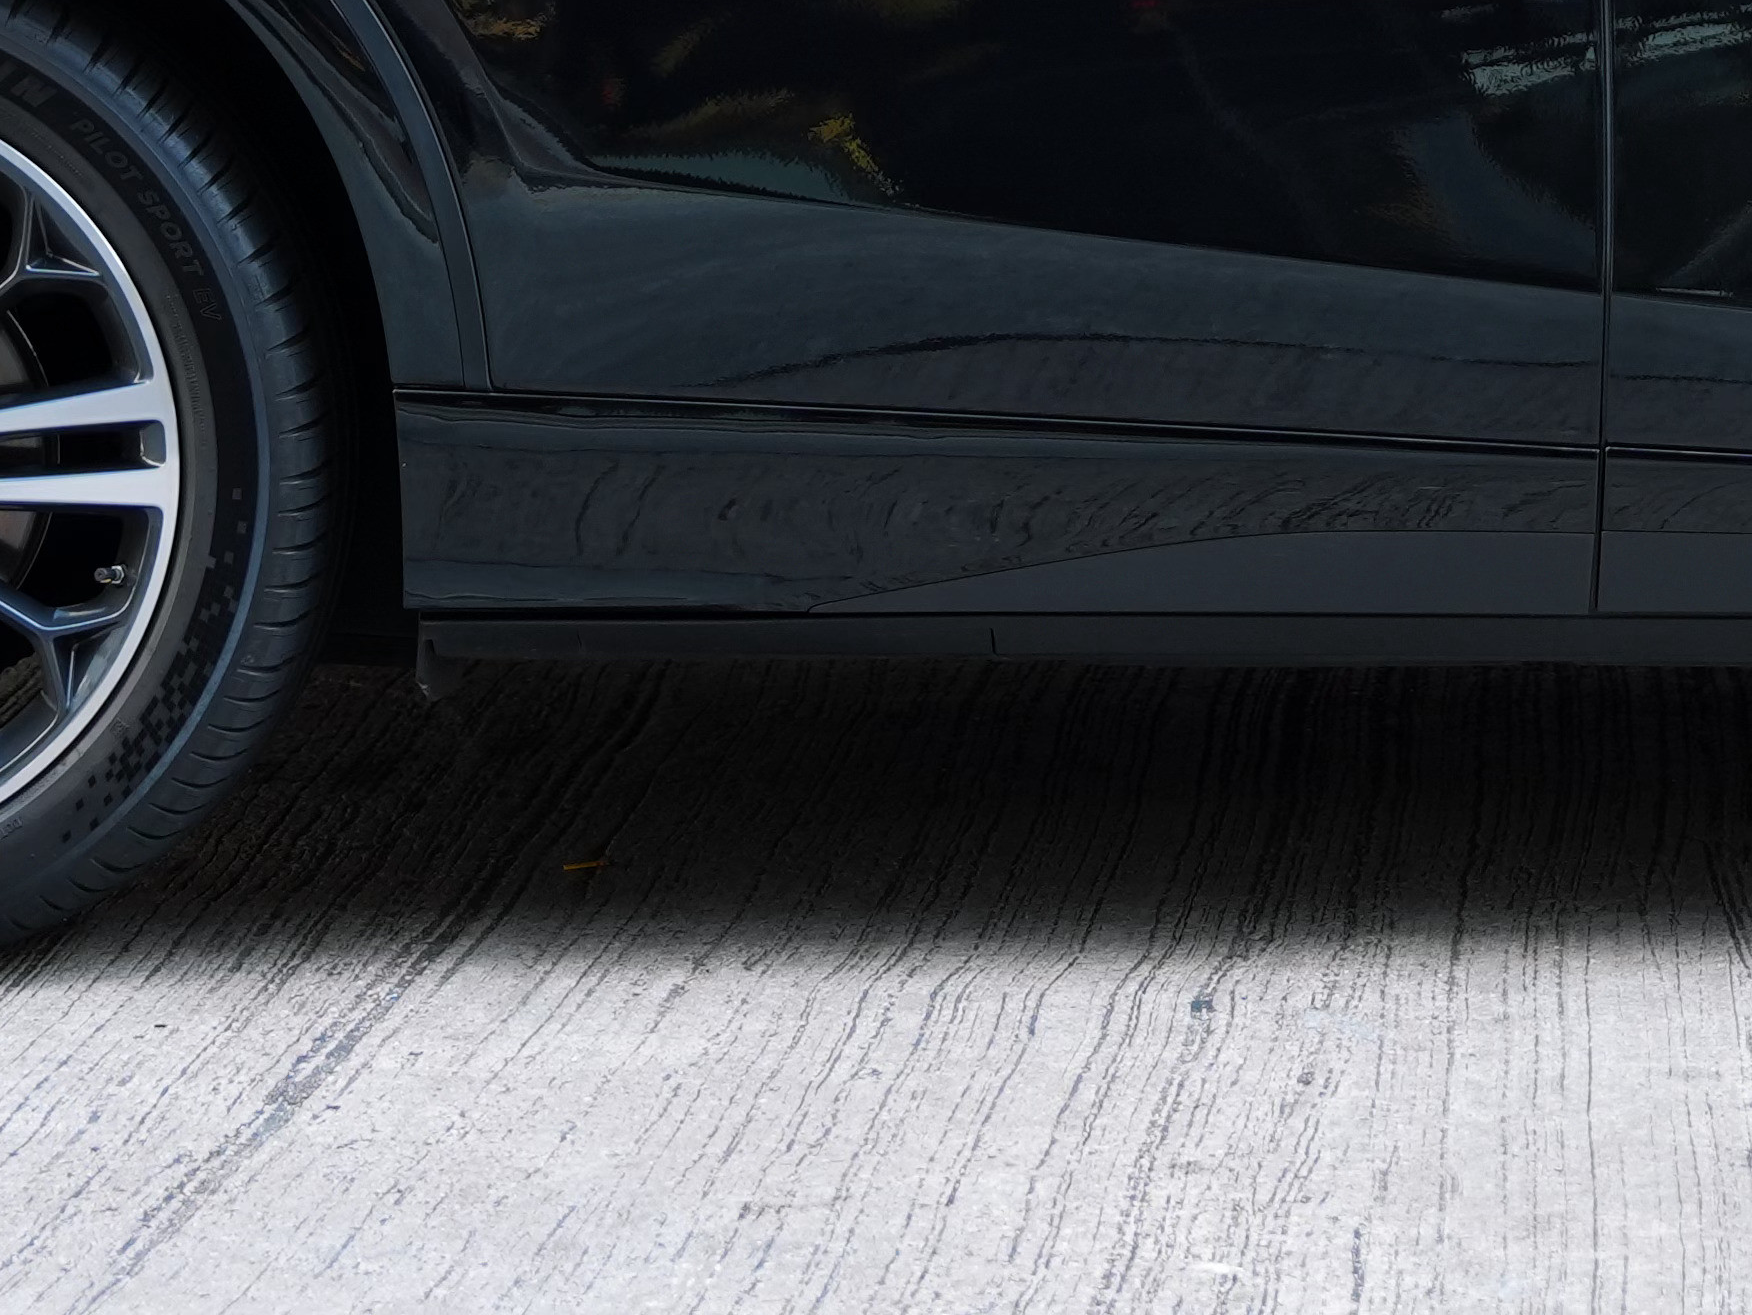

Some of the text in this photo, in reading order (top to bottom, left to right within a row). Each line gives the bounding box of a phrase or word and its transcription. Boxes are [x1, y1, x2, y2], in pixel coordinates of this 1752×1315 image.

[67, 113, 144, 190] PILOT
[134, 184, 205, 281] SPORT
[191, 283, 223, 325] EV
